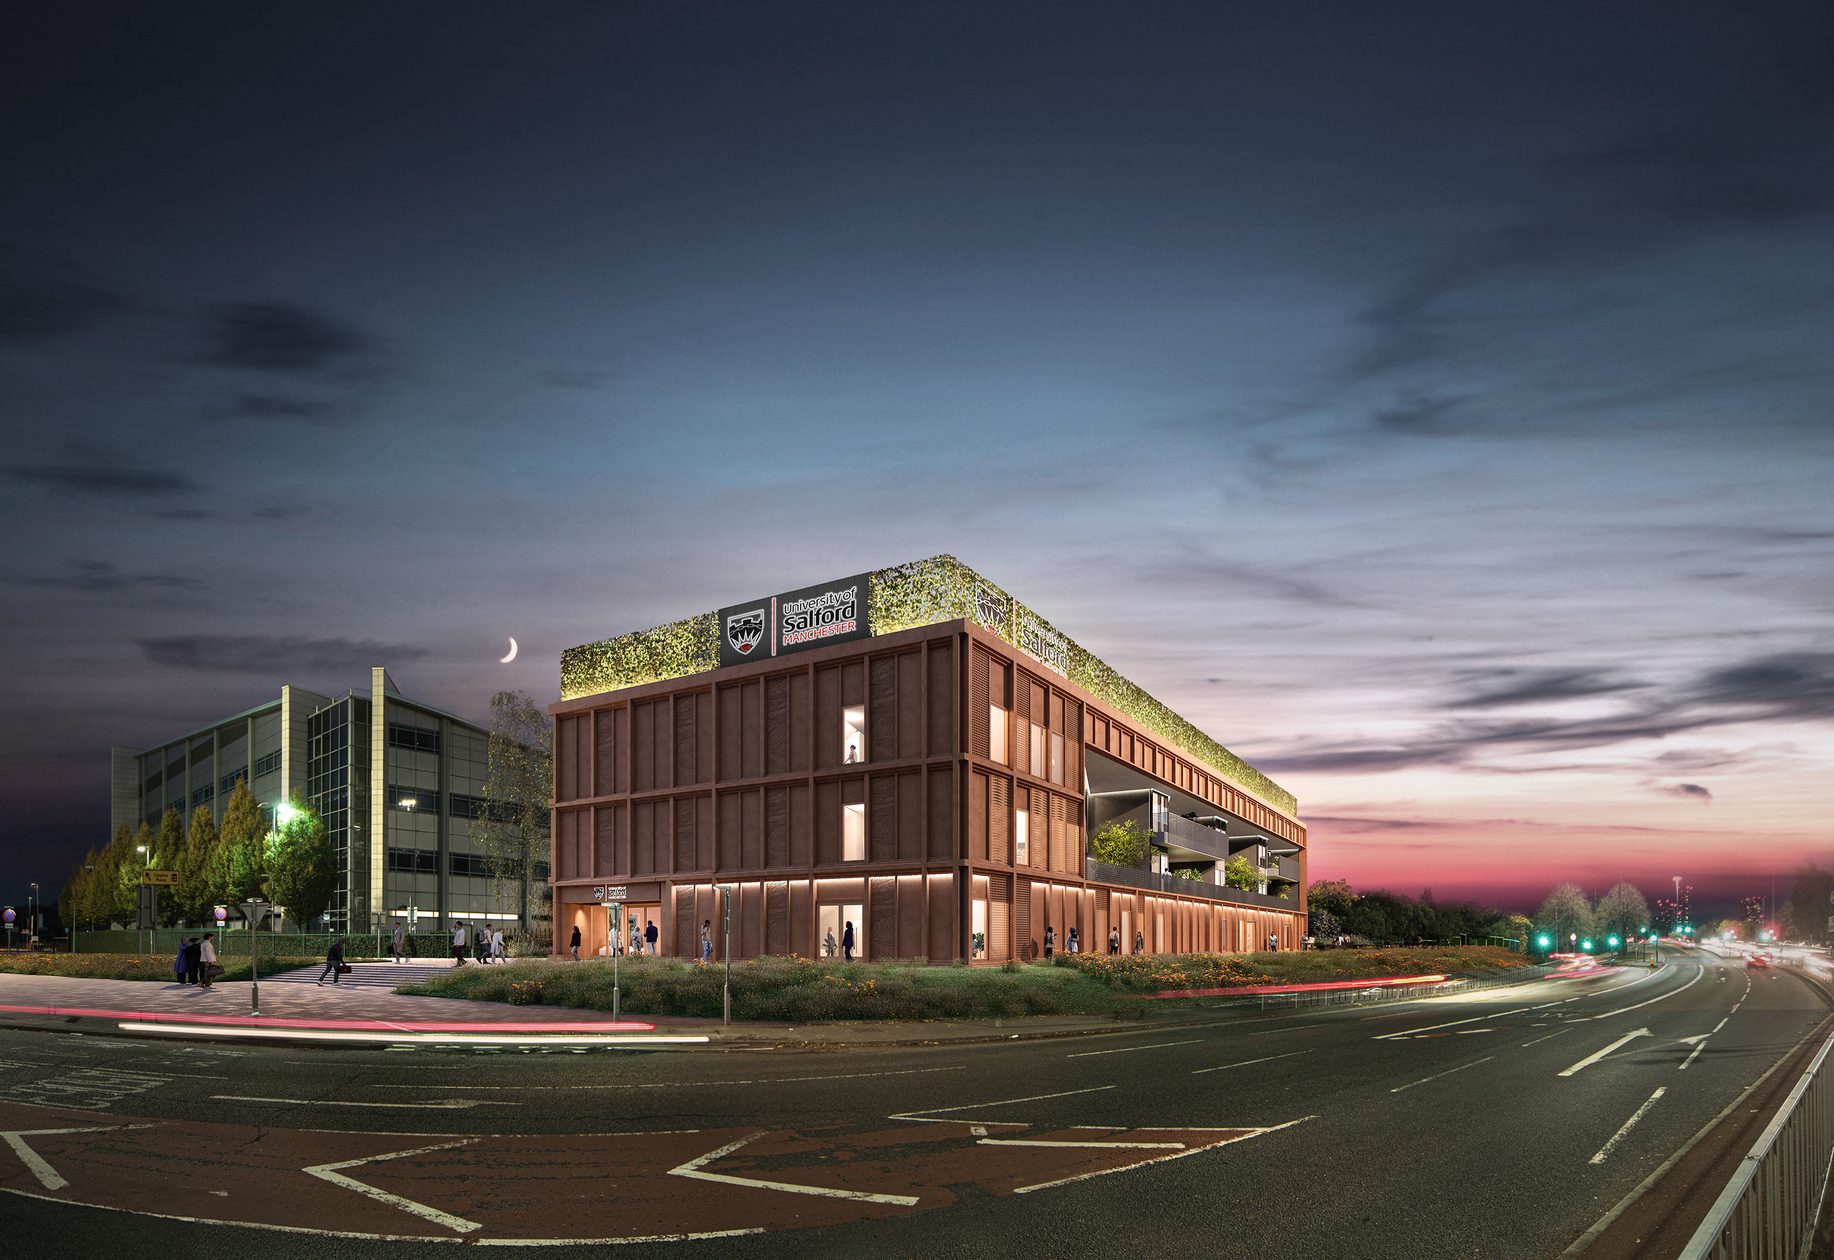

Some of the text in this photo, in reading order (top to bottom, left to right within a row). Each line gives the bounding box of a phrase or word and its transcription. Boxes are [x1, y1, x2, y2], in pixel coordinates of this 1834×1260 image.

[783, 585, 857, 615] University of
[783, 599, 857, 634] Salford
[782, 620, 857, 647] MANCHESTER
[1021, 627, 1068, 671] Salford
